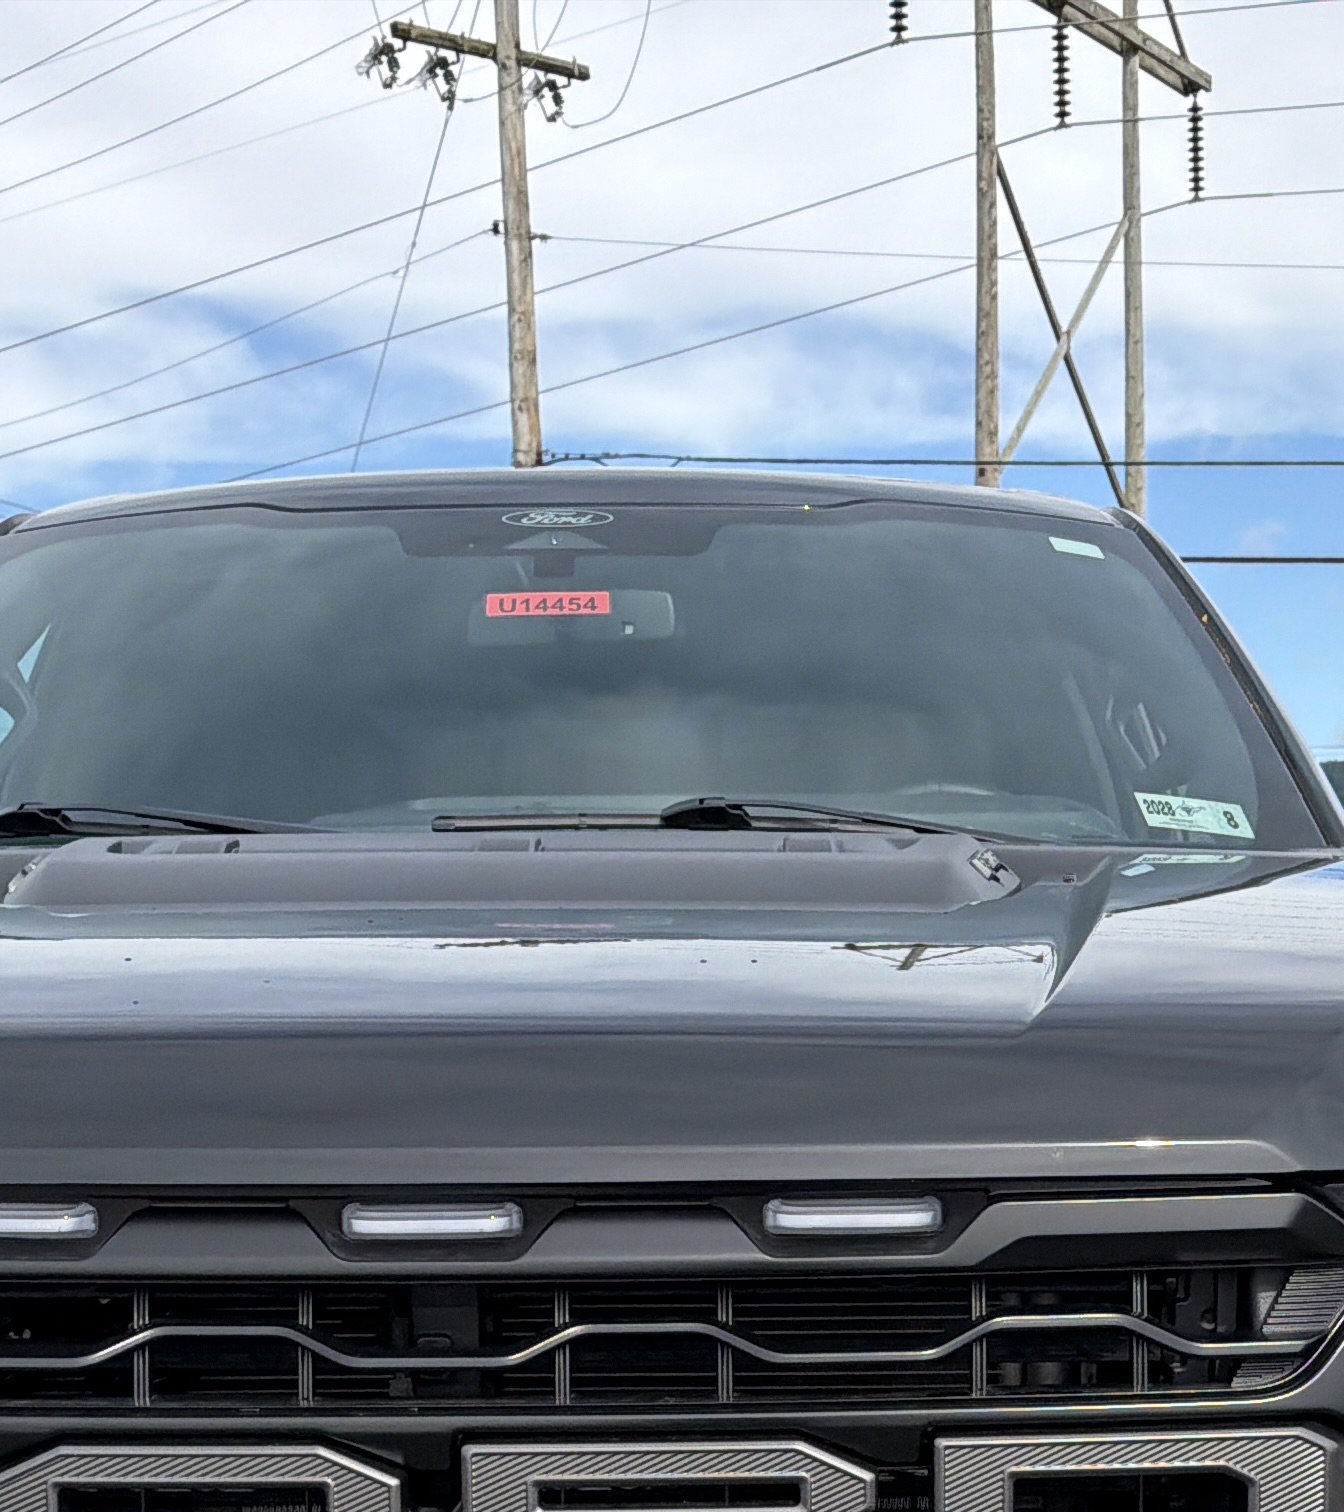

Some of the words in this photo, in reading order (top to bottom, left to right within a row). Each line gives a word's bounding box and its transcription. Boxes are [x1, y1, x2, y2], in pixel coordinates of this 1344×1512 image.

[519, 510, 595, 525] Ford
[498, 596, 599, 614] U14454
[1142, 798, 1176, 817] 2028
[1222, 810, 1240, 830] 8
